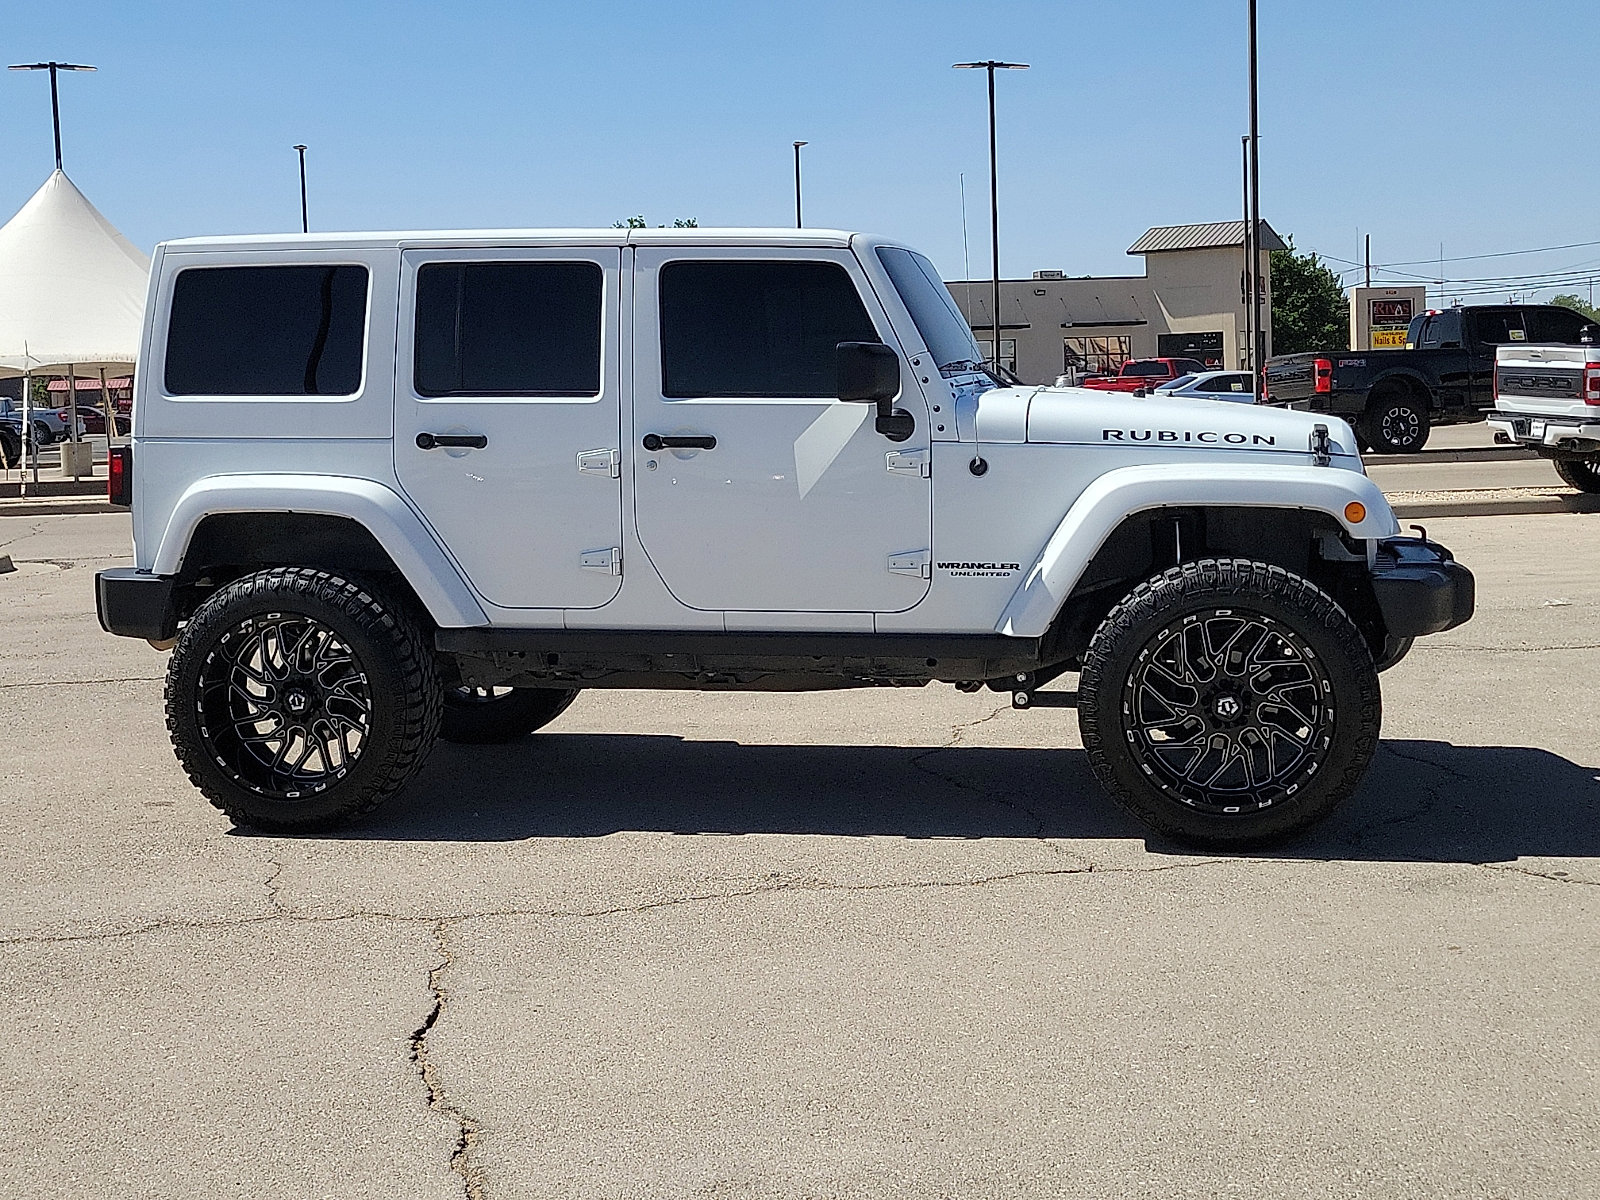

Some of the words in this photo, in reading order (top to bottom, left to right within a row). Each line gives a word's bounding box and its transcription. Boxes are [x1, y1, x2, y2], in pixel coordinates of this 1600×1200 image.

[1374, 336, 1391, 345] Nails
[1391, 336, 1397, 345] &
[1398, 335, 1407, 346] Sp
[1102, 429, 1276, 446] RUBICON
[937, 562, 1021, 571] WRANGLER
